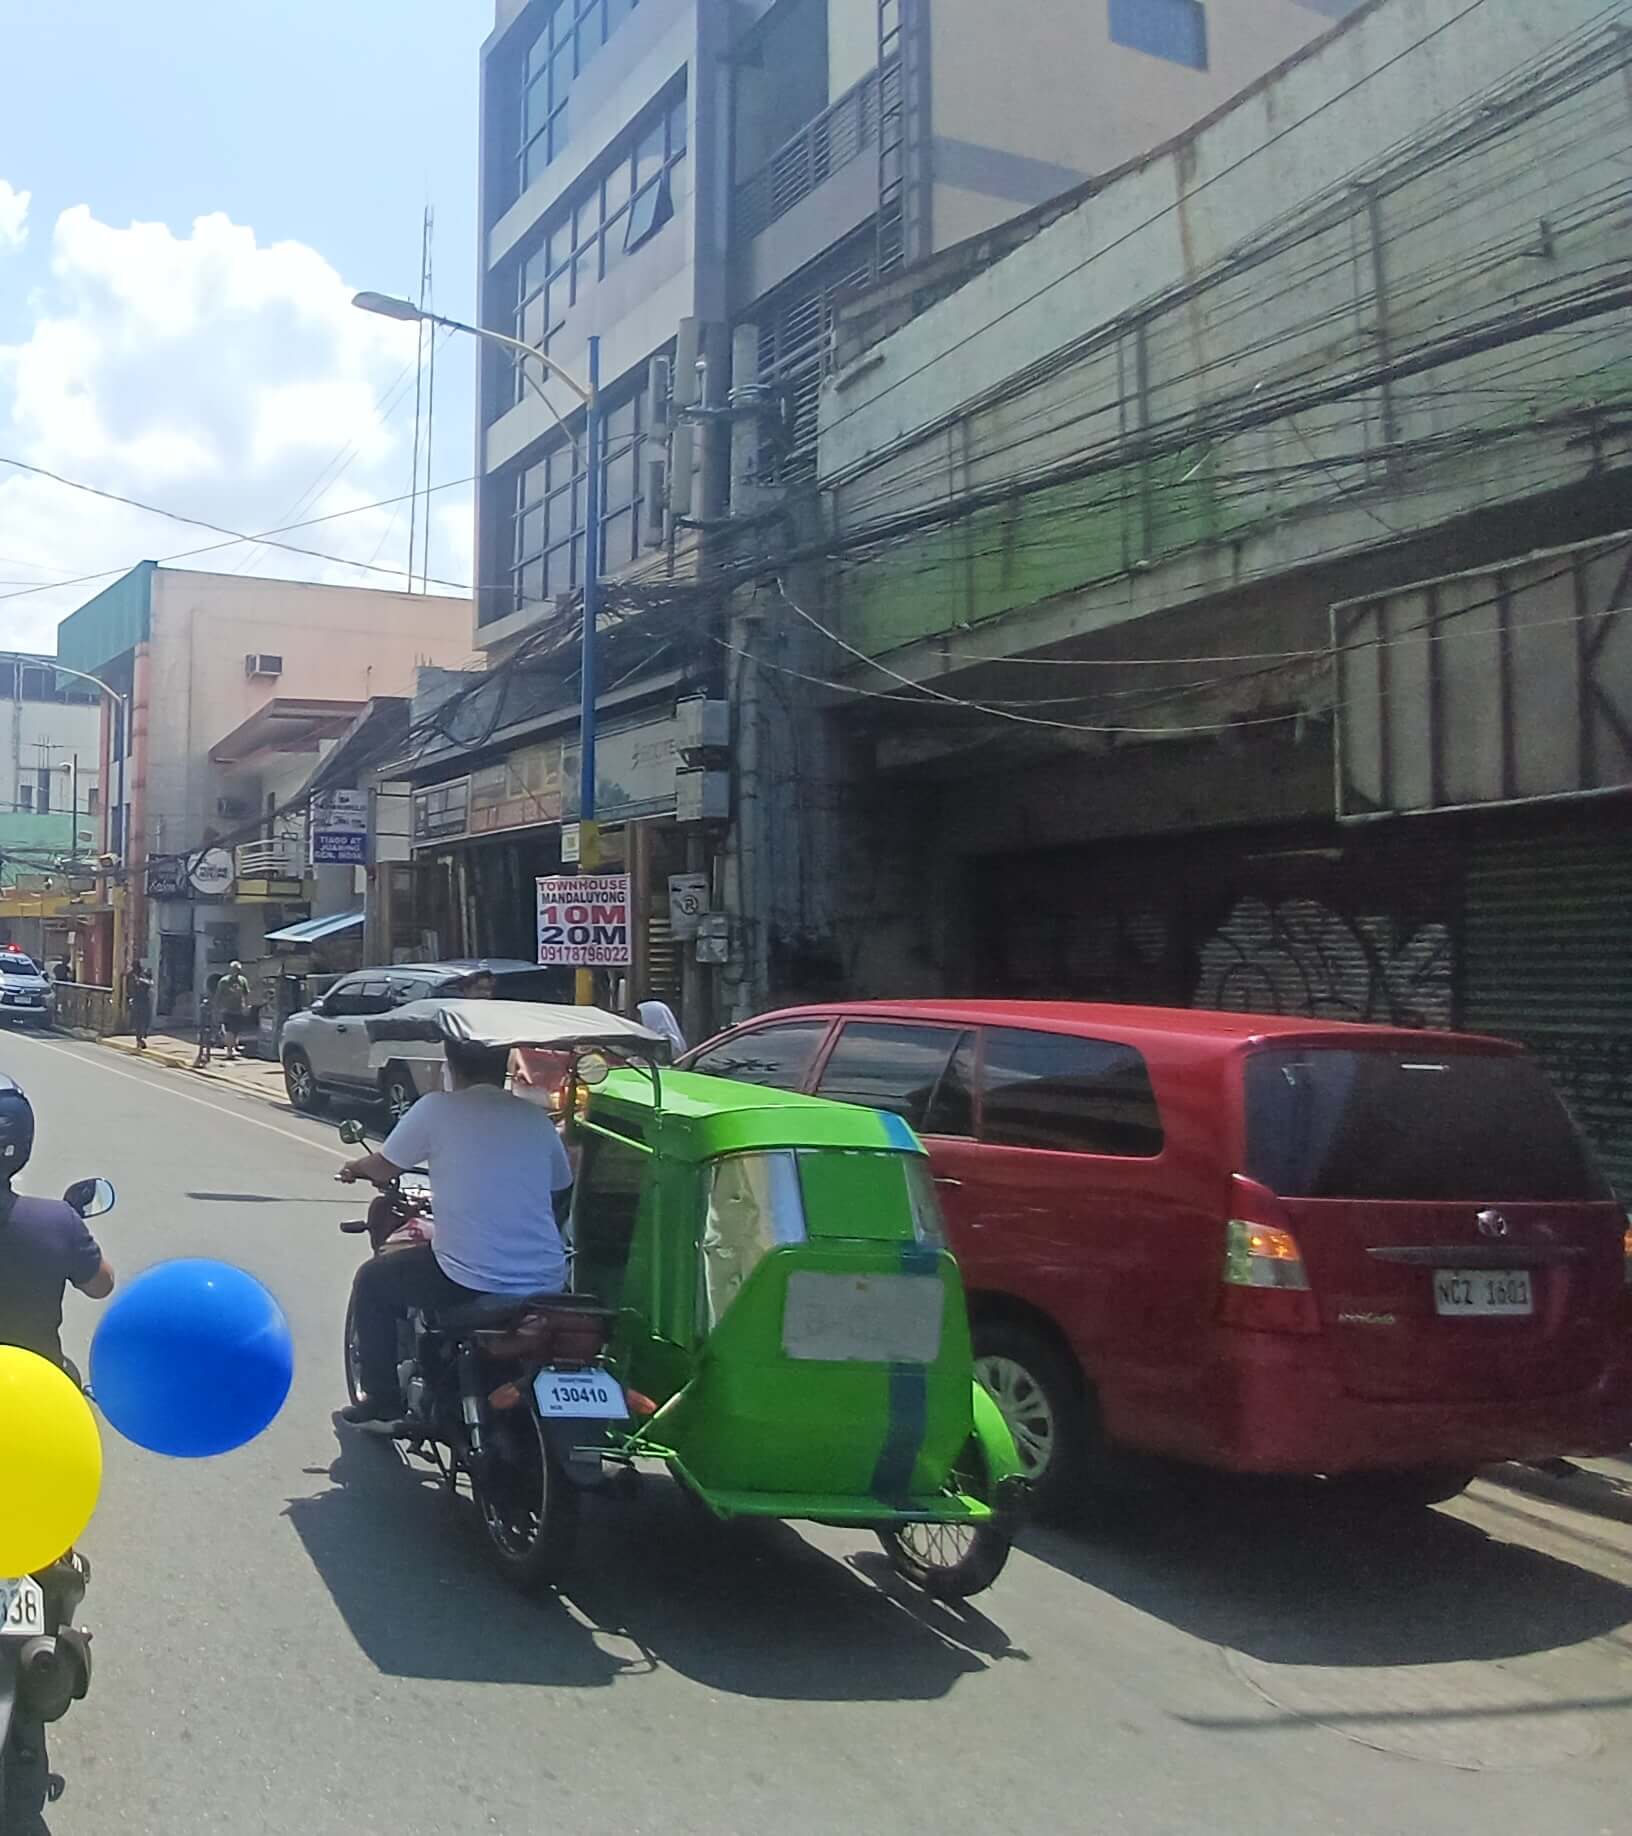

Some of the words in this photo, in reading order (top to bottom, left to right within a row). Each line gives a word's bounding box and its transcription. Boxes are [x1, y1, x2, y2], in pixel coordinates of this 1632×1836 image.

[539, 880, 627, 891] TOWNHOUSE
[541, 891, 625, 904] MANDALUYONG
[540, 904, 626, 925] 10M
[541, 926, 626, 945] 20M
[541, 946, 628, 961] 09178796022
[552, 1387, 608, 1403] 130410
